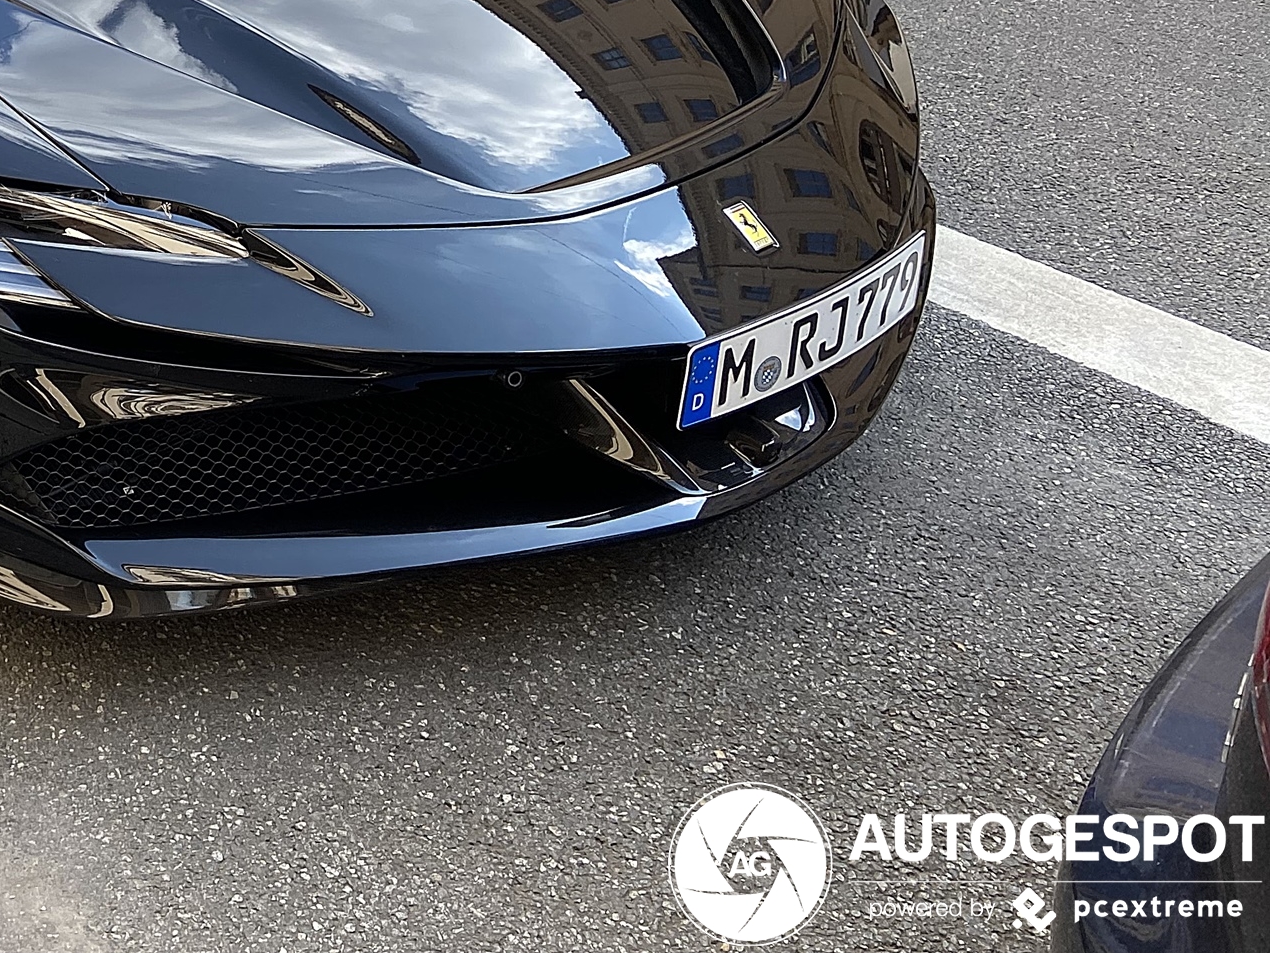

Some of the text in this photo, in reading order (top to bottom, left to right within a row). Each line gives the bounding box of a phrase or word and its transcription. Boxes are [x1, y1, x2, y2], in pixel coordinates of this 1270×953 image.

[718, 251, 919, 407] M RJ 779
[692, 392, 705, 412] D
